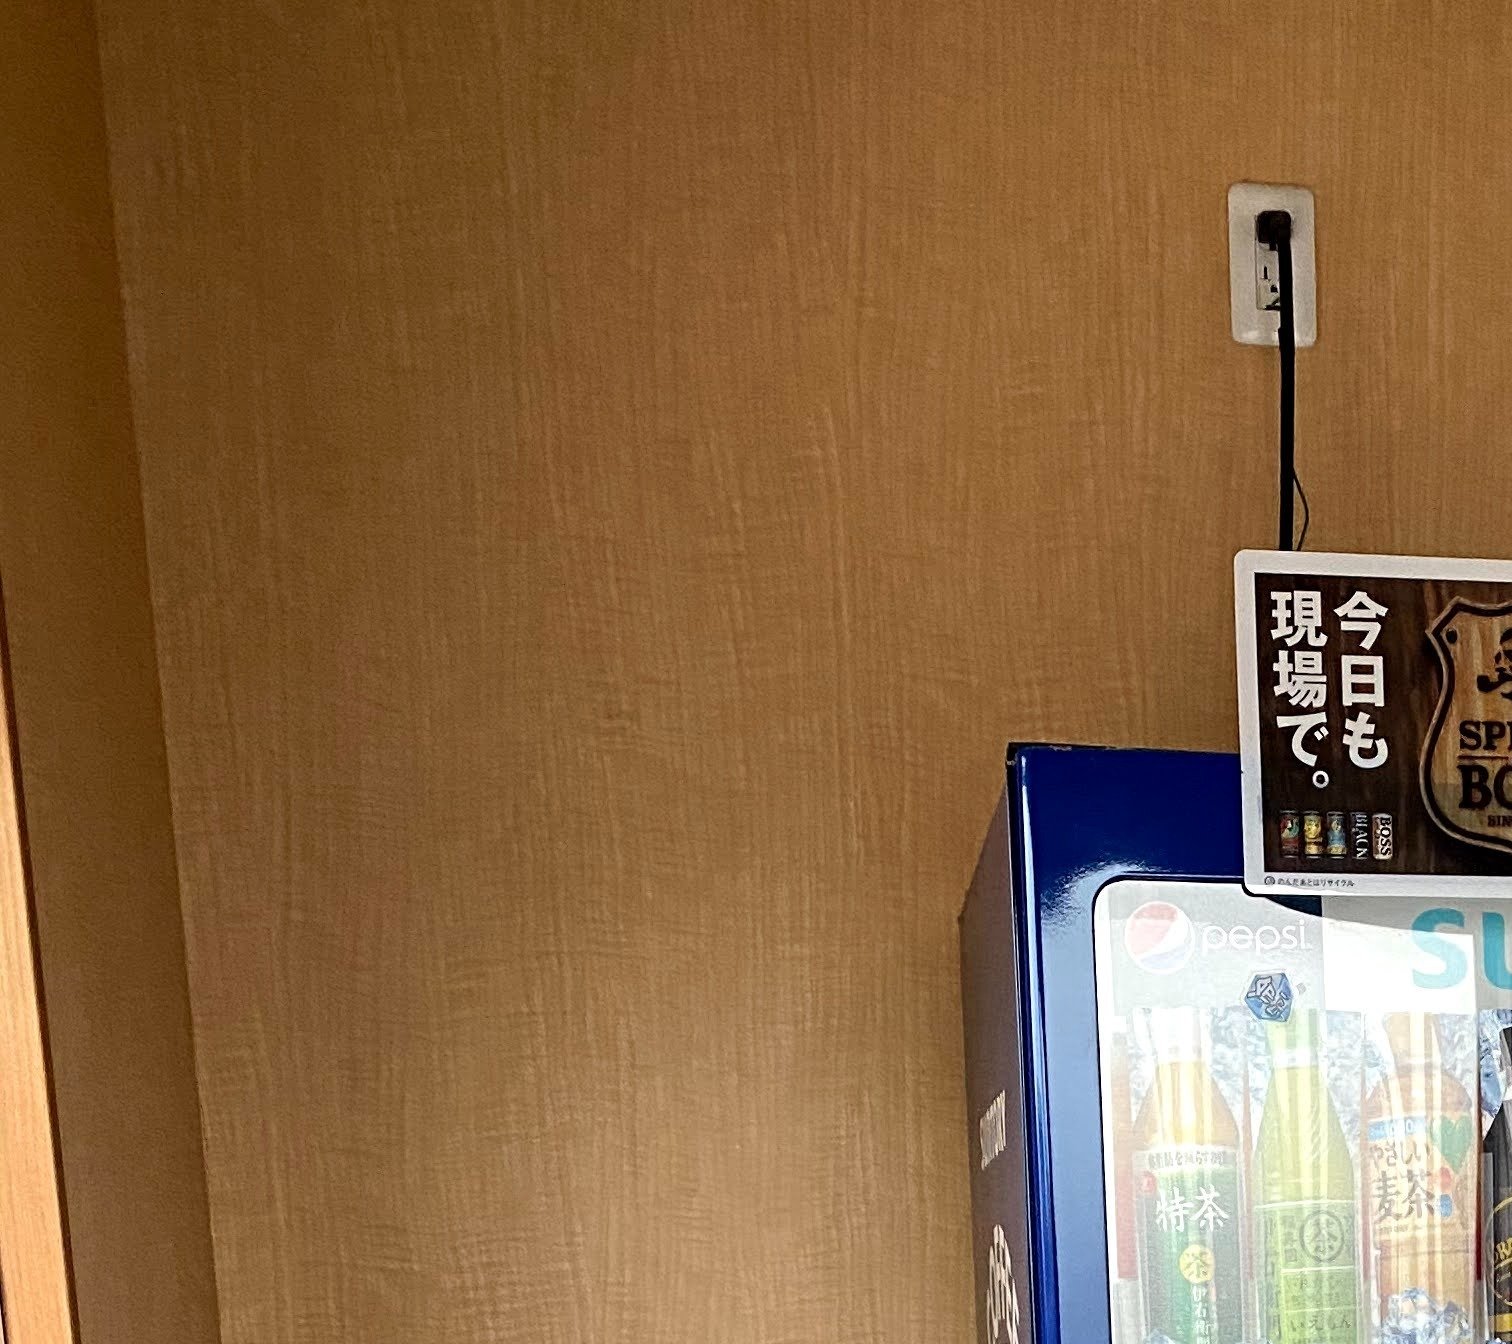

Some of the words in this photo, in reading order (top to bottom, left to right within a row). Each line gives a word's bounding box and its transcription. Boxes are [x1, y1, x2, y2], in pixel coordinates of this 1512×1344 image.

[1270, 591, 1329, 788] 現場で。
[1334, 592, 1389, 768] 今日も
[1200, 918, 1307, 965] pepsi
[1370, 1141, 1430, 1167] やさしい
[1156, 1184, 1229, 1232] 特茶
[1373, 1169, 1434, 1223] 麦茶
